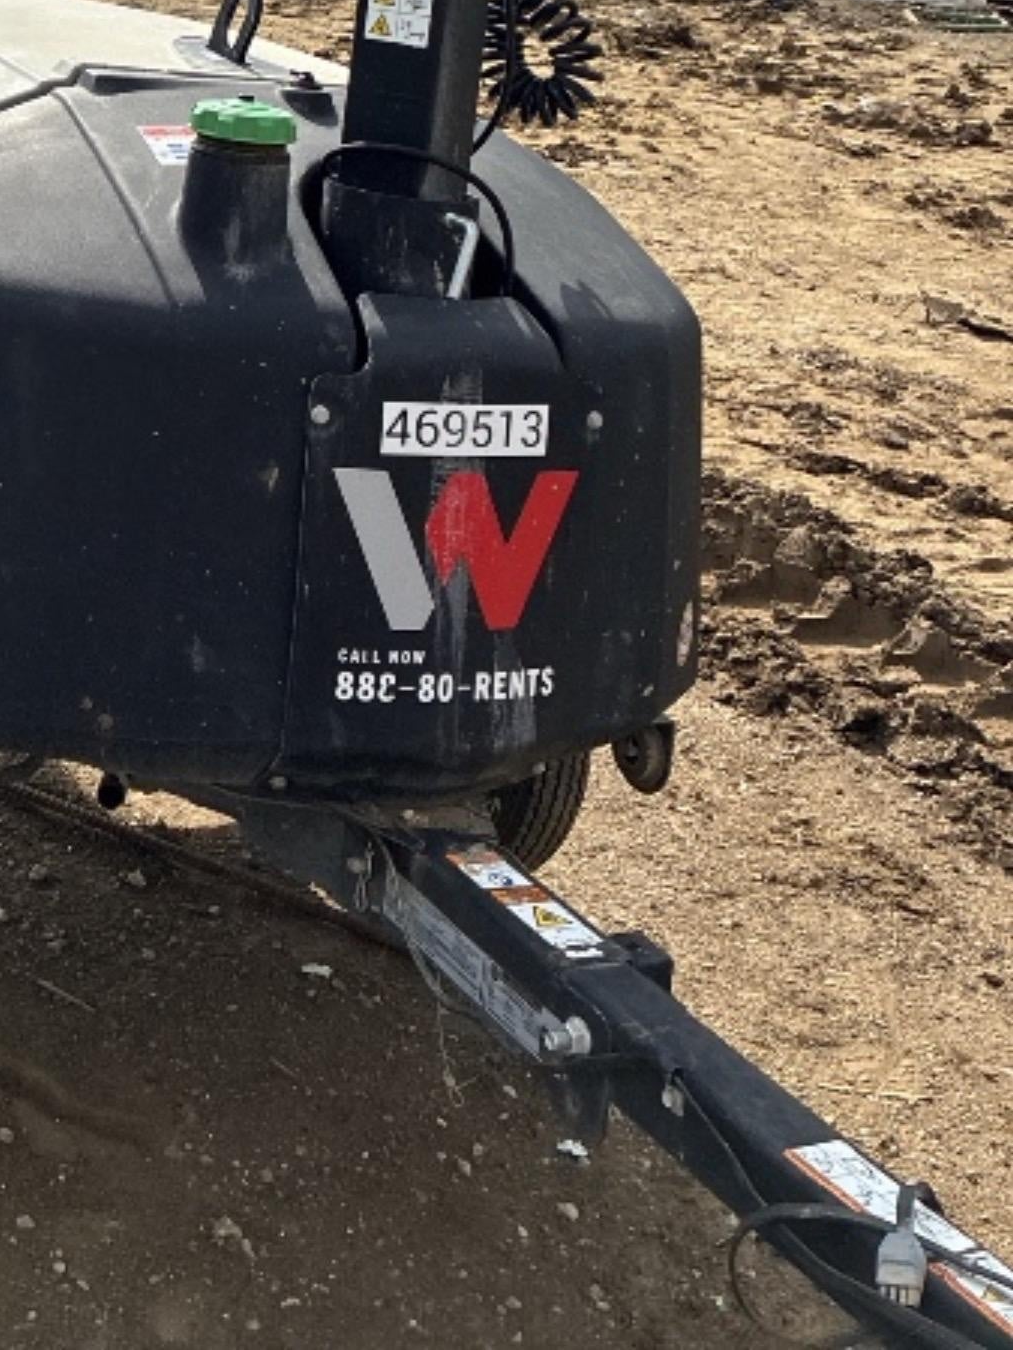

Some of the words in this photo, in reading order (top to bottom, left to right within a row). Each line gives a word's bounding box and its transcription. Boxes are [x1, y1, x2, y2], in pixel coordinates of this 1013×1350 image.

[385, 406, 543, 448] 469513
[337, 647, 381, 664] CALL
[388, 649, 427, 665] NOW
